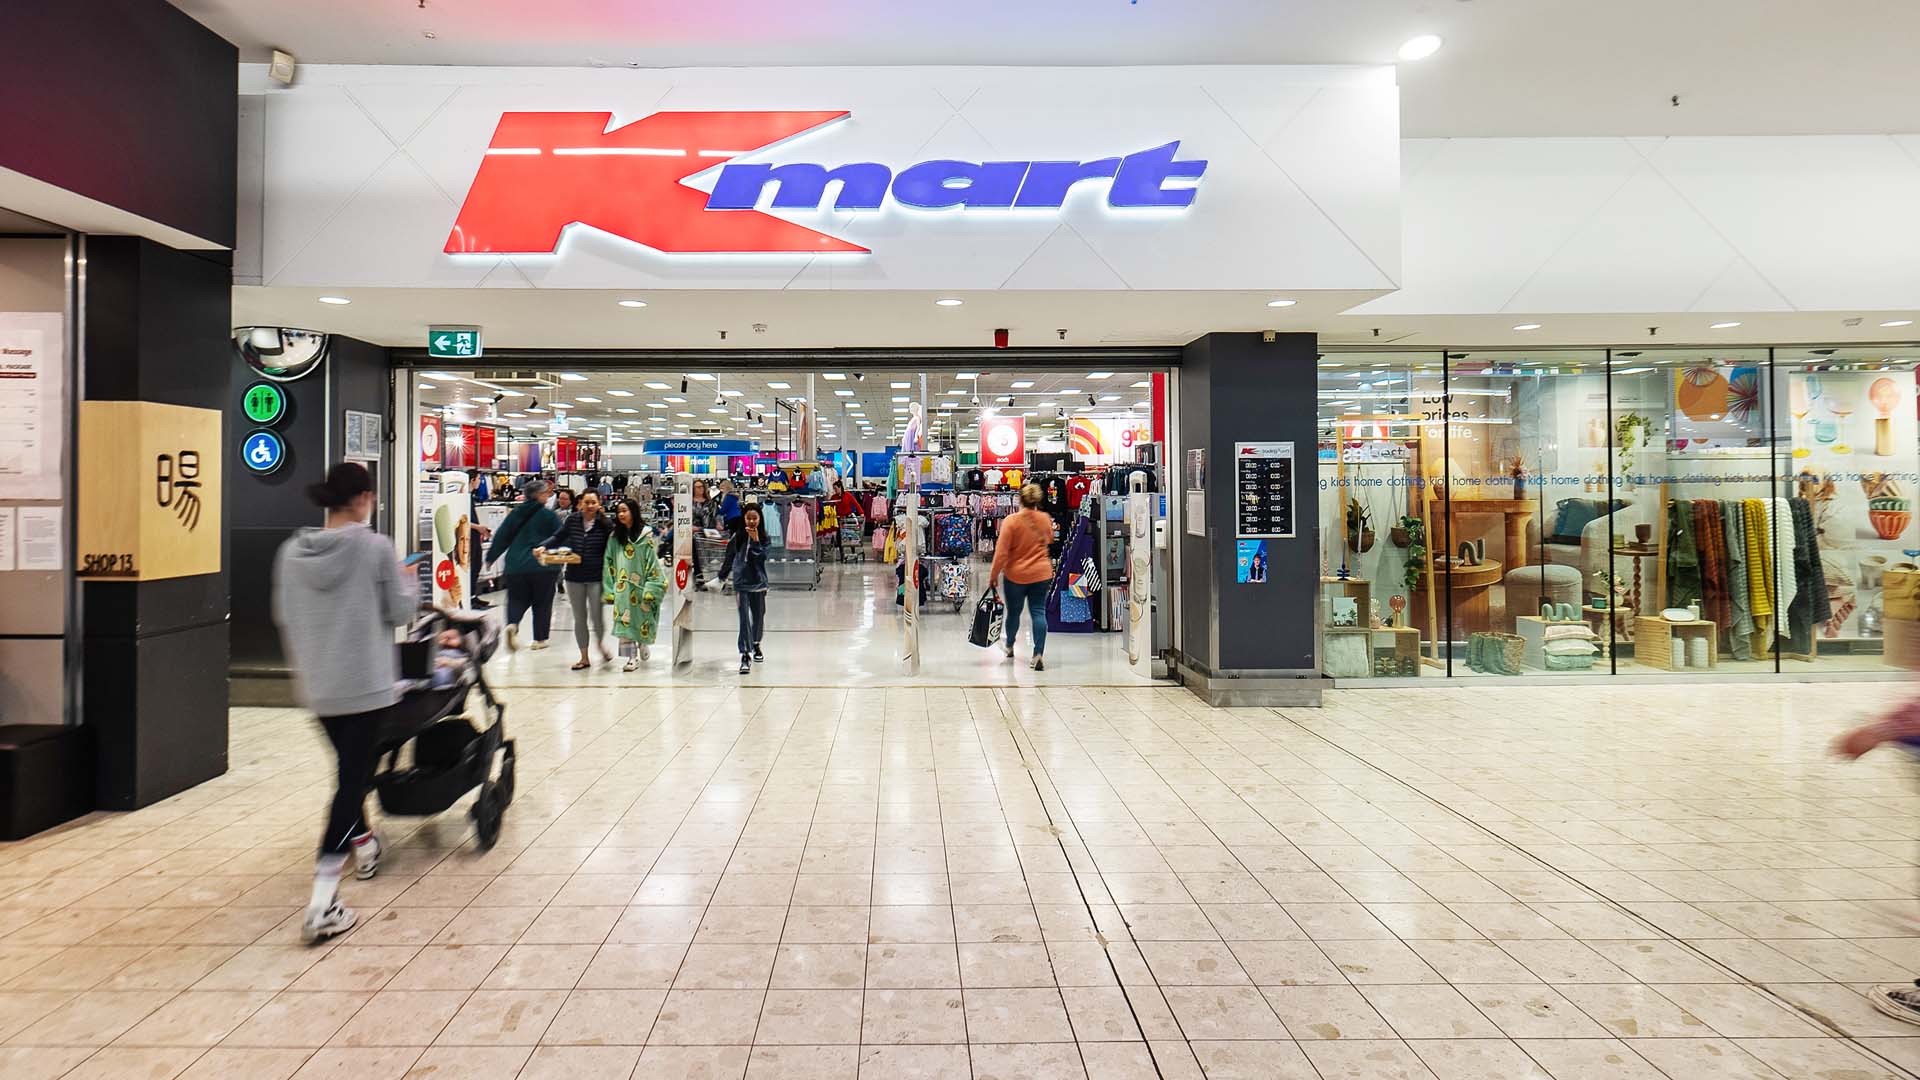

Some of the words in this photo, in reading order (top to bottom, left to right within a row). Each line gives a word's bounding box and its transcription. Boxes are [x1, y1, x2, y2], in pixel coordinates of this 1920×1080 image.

[444, 111, 1208, 256] Kmart
[1122, 423, 1151, 448] girls
[664, 441, 686, 450] please
[686, 442, 701, 451] pay
[702, 441, 718, 449] here
[1330, 475, 1351, 487] kids
[1354, 475, 1383, 487] home
[1429, 475, 1445, 487] kid
[1452, 475, 1481, 486] home
[1485, 474, 1525, 489] cloth
[1528, 474, 1548, 486] kids
[1551, 474, 1580, 485] home
[1584, 473, 1623, 488] clothg
[1880, 471, 1919, 485] othing
[84, 553, 118, 572] SHOP
[120, 553, 133, 571] 13
